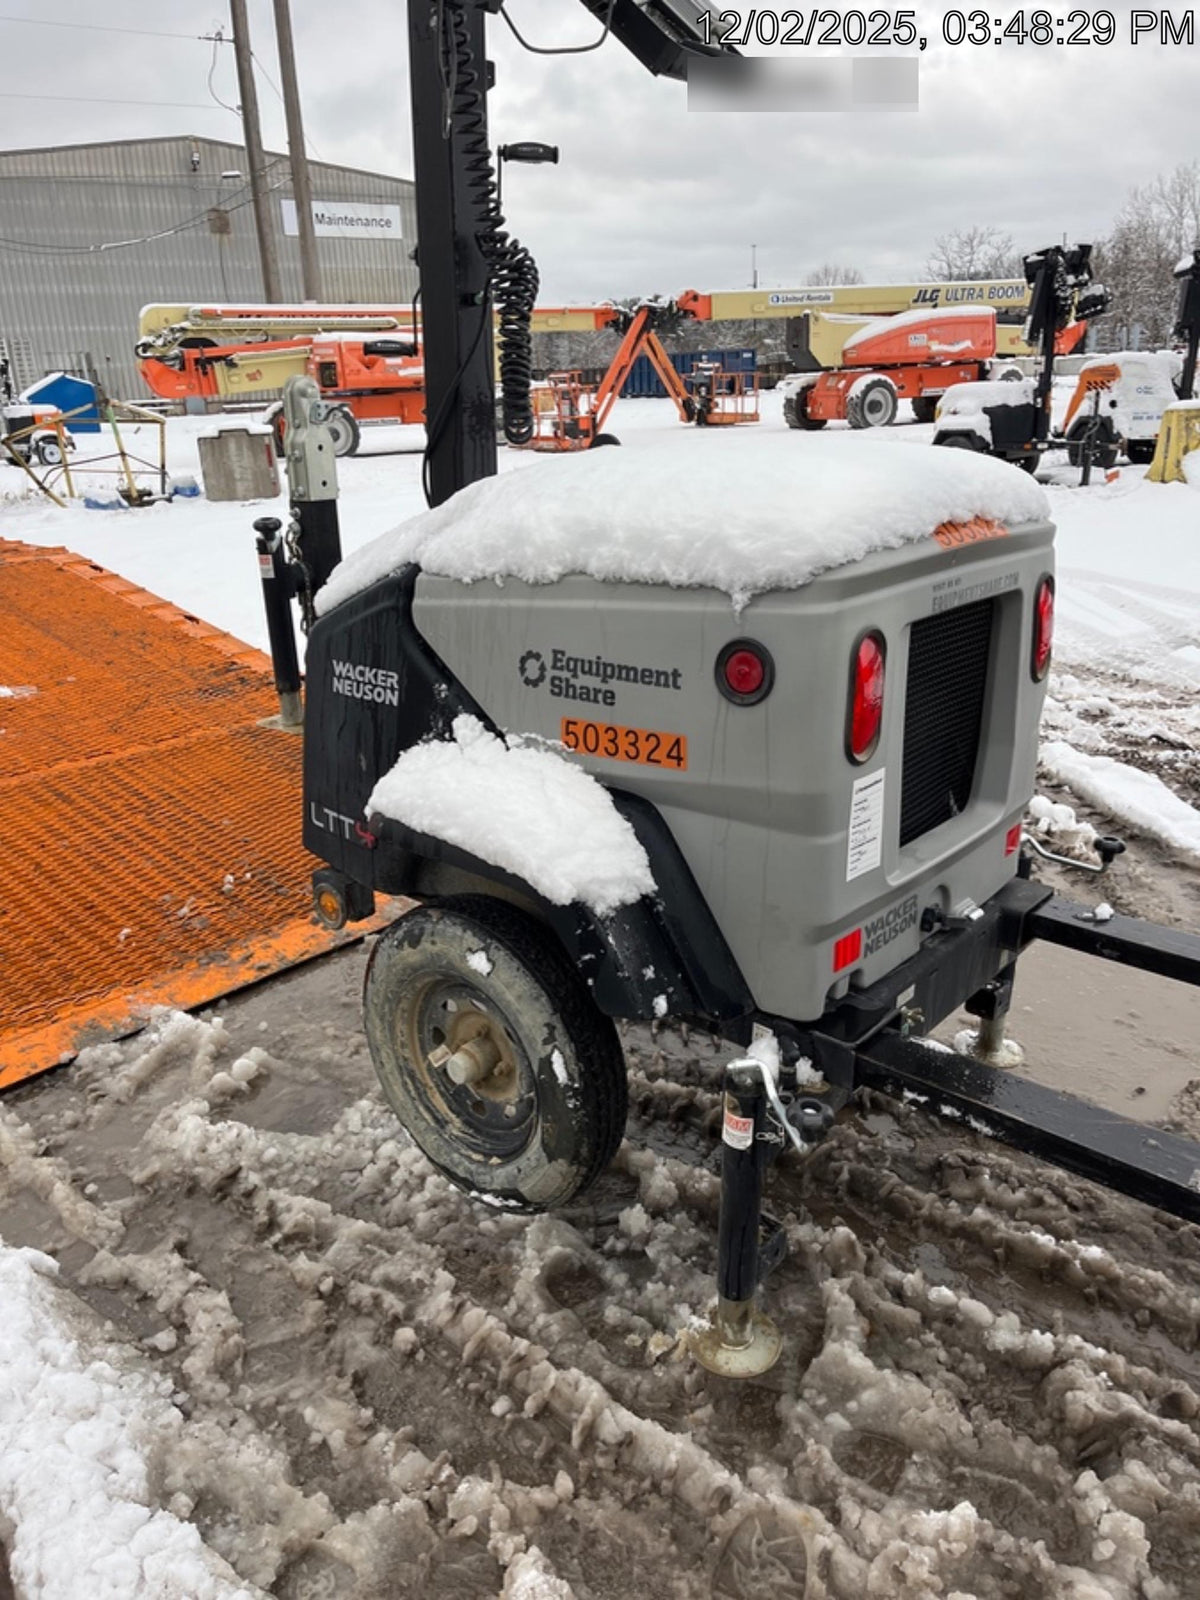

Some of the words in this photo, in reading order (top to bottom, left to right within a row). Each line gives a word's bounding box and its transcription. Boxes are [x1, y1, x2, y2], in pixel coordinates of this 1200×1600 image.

[314, 213, 392, 228] Maintenance
[912, 289, 941, 303] JLG
[945, 287, 984, 301] ULTRA
[987, 285, 1025, 300] BOOM
[332, 659, 399, 689] WACKER
[551, 649, 682, 690] Equipment
[332, 676, 399, 706] NEUSON
[550, 675, 616, 707] Share
[564, 719, 684, 768] 503324
[864, 894, 919, 939] WACKER
[863, 911, 918, 959] NEUSON
